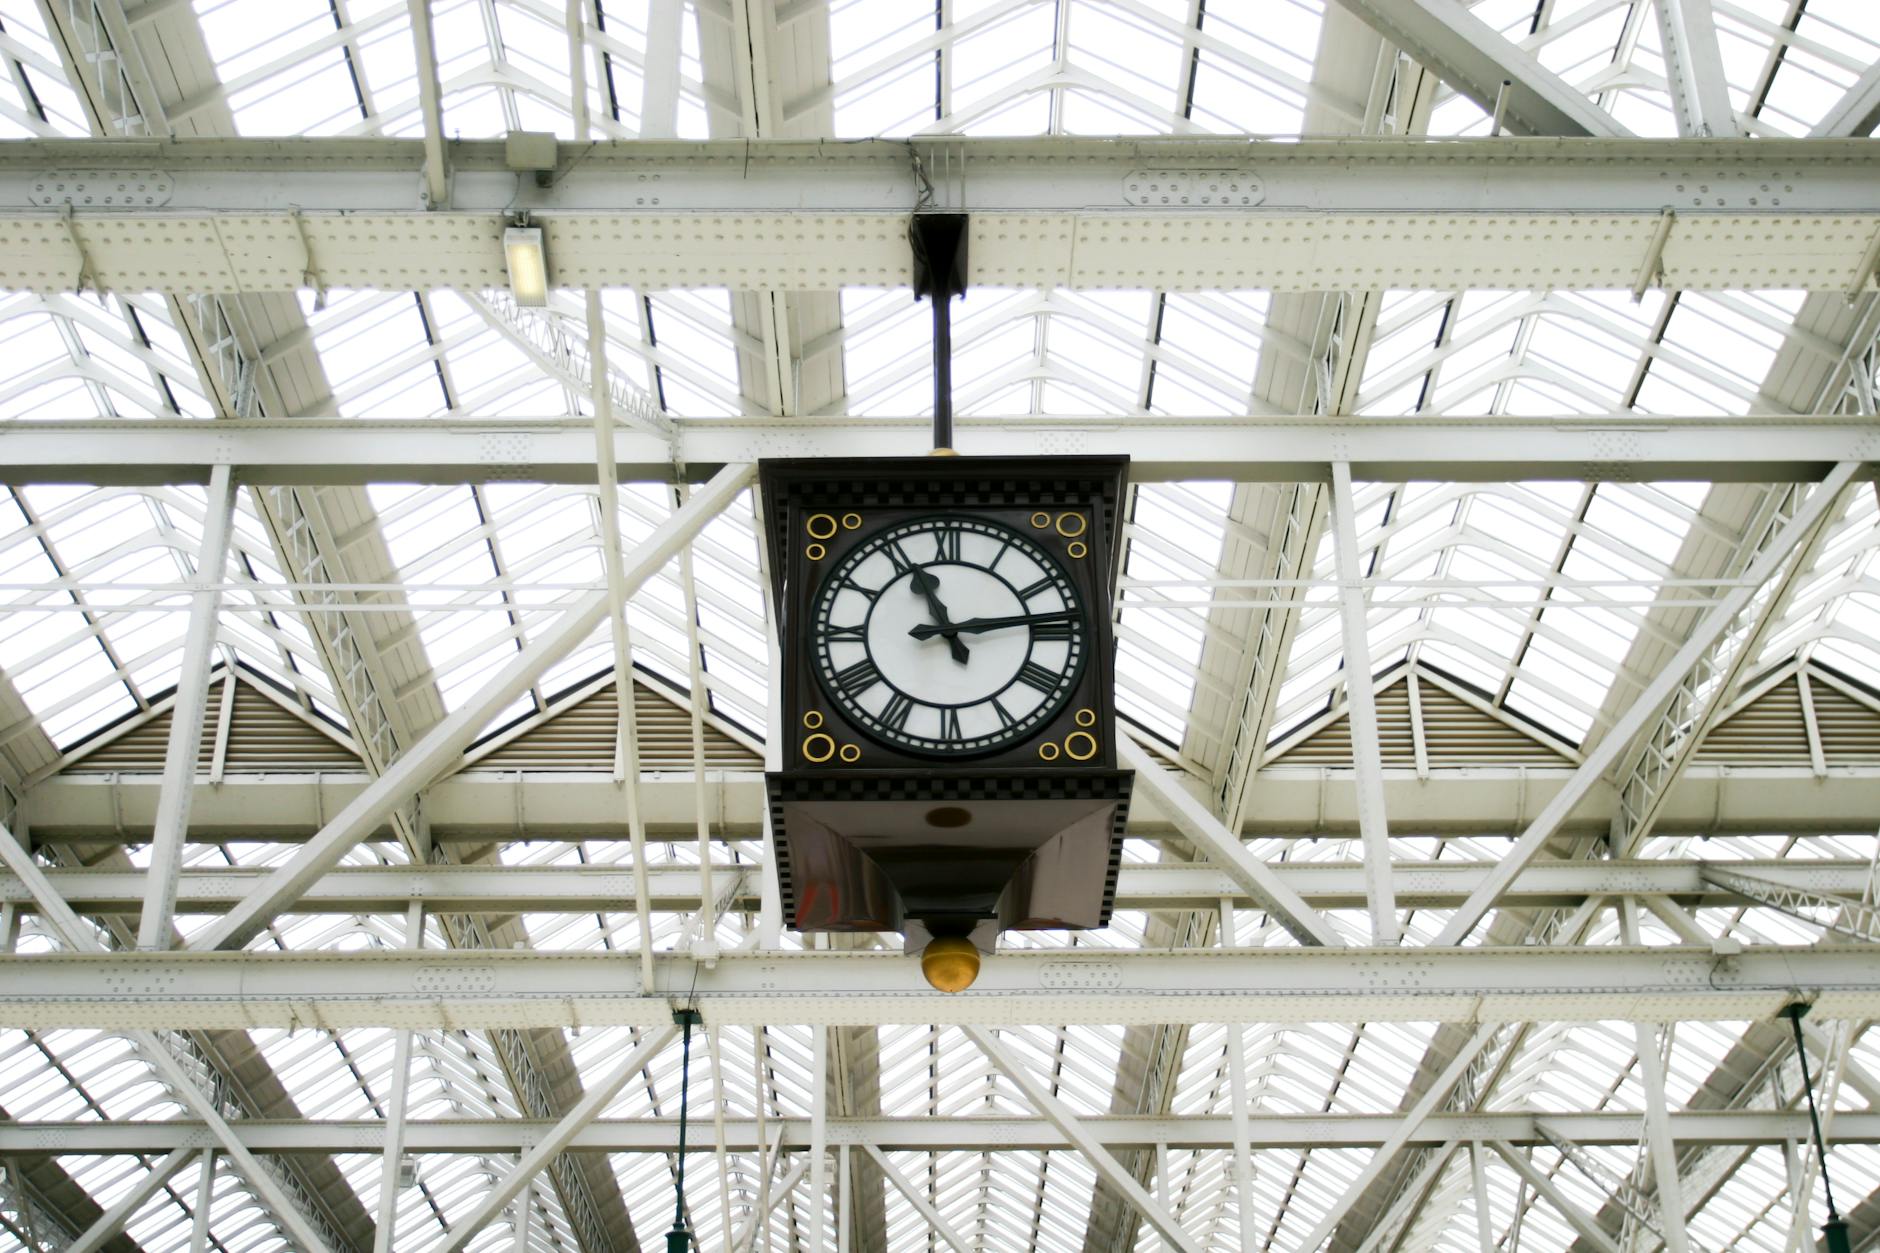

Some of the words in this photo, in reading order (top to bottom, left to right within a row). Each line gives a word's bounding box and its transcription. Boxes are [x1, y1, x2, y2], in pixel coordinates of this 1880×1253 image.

[880, 541, 912, 575] XI
[933, 530, 961, 561] XII
[989, 543, 1009, 571] I
[840, 577, 880, 601] X
[1018, 576, 1055, 601] II
[828, 624, 865, 642] IX
[1031, 624, 1070, 641] III
[836, 659, 881, 699] VIII
[1016, 661, 1061, 695] IIII
[878, 692, 914, 731] VII
[940, 708, 962, 740] VI
[991, 698, 1017, 728] V
